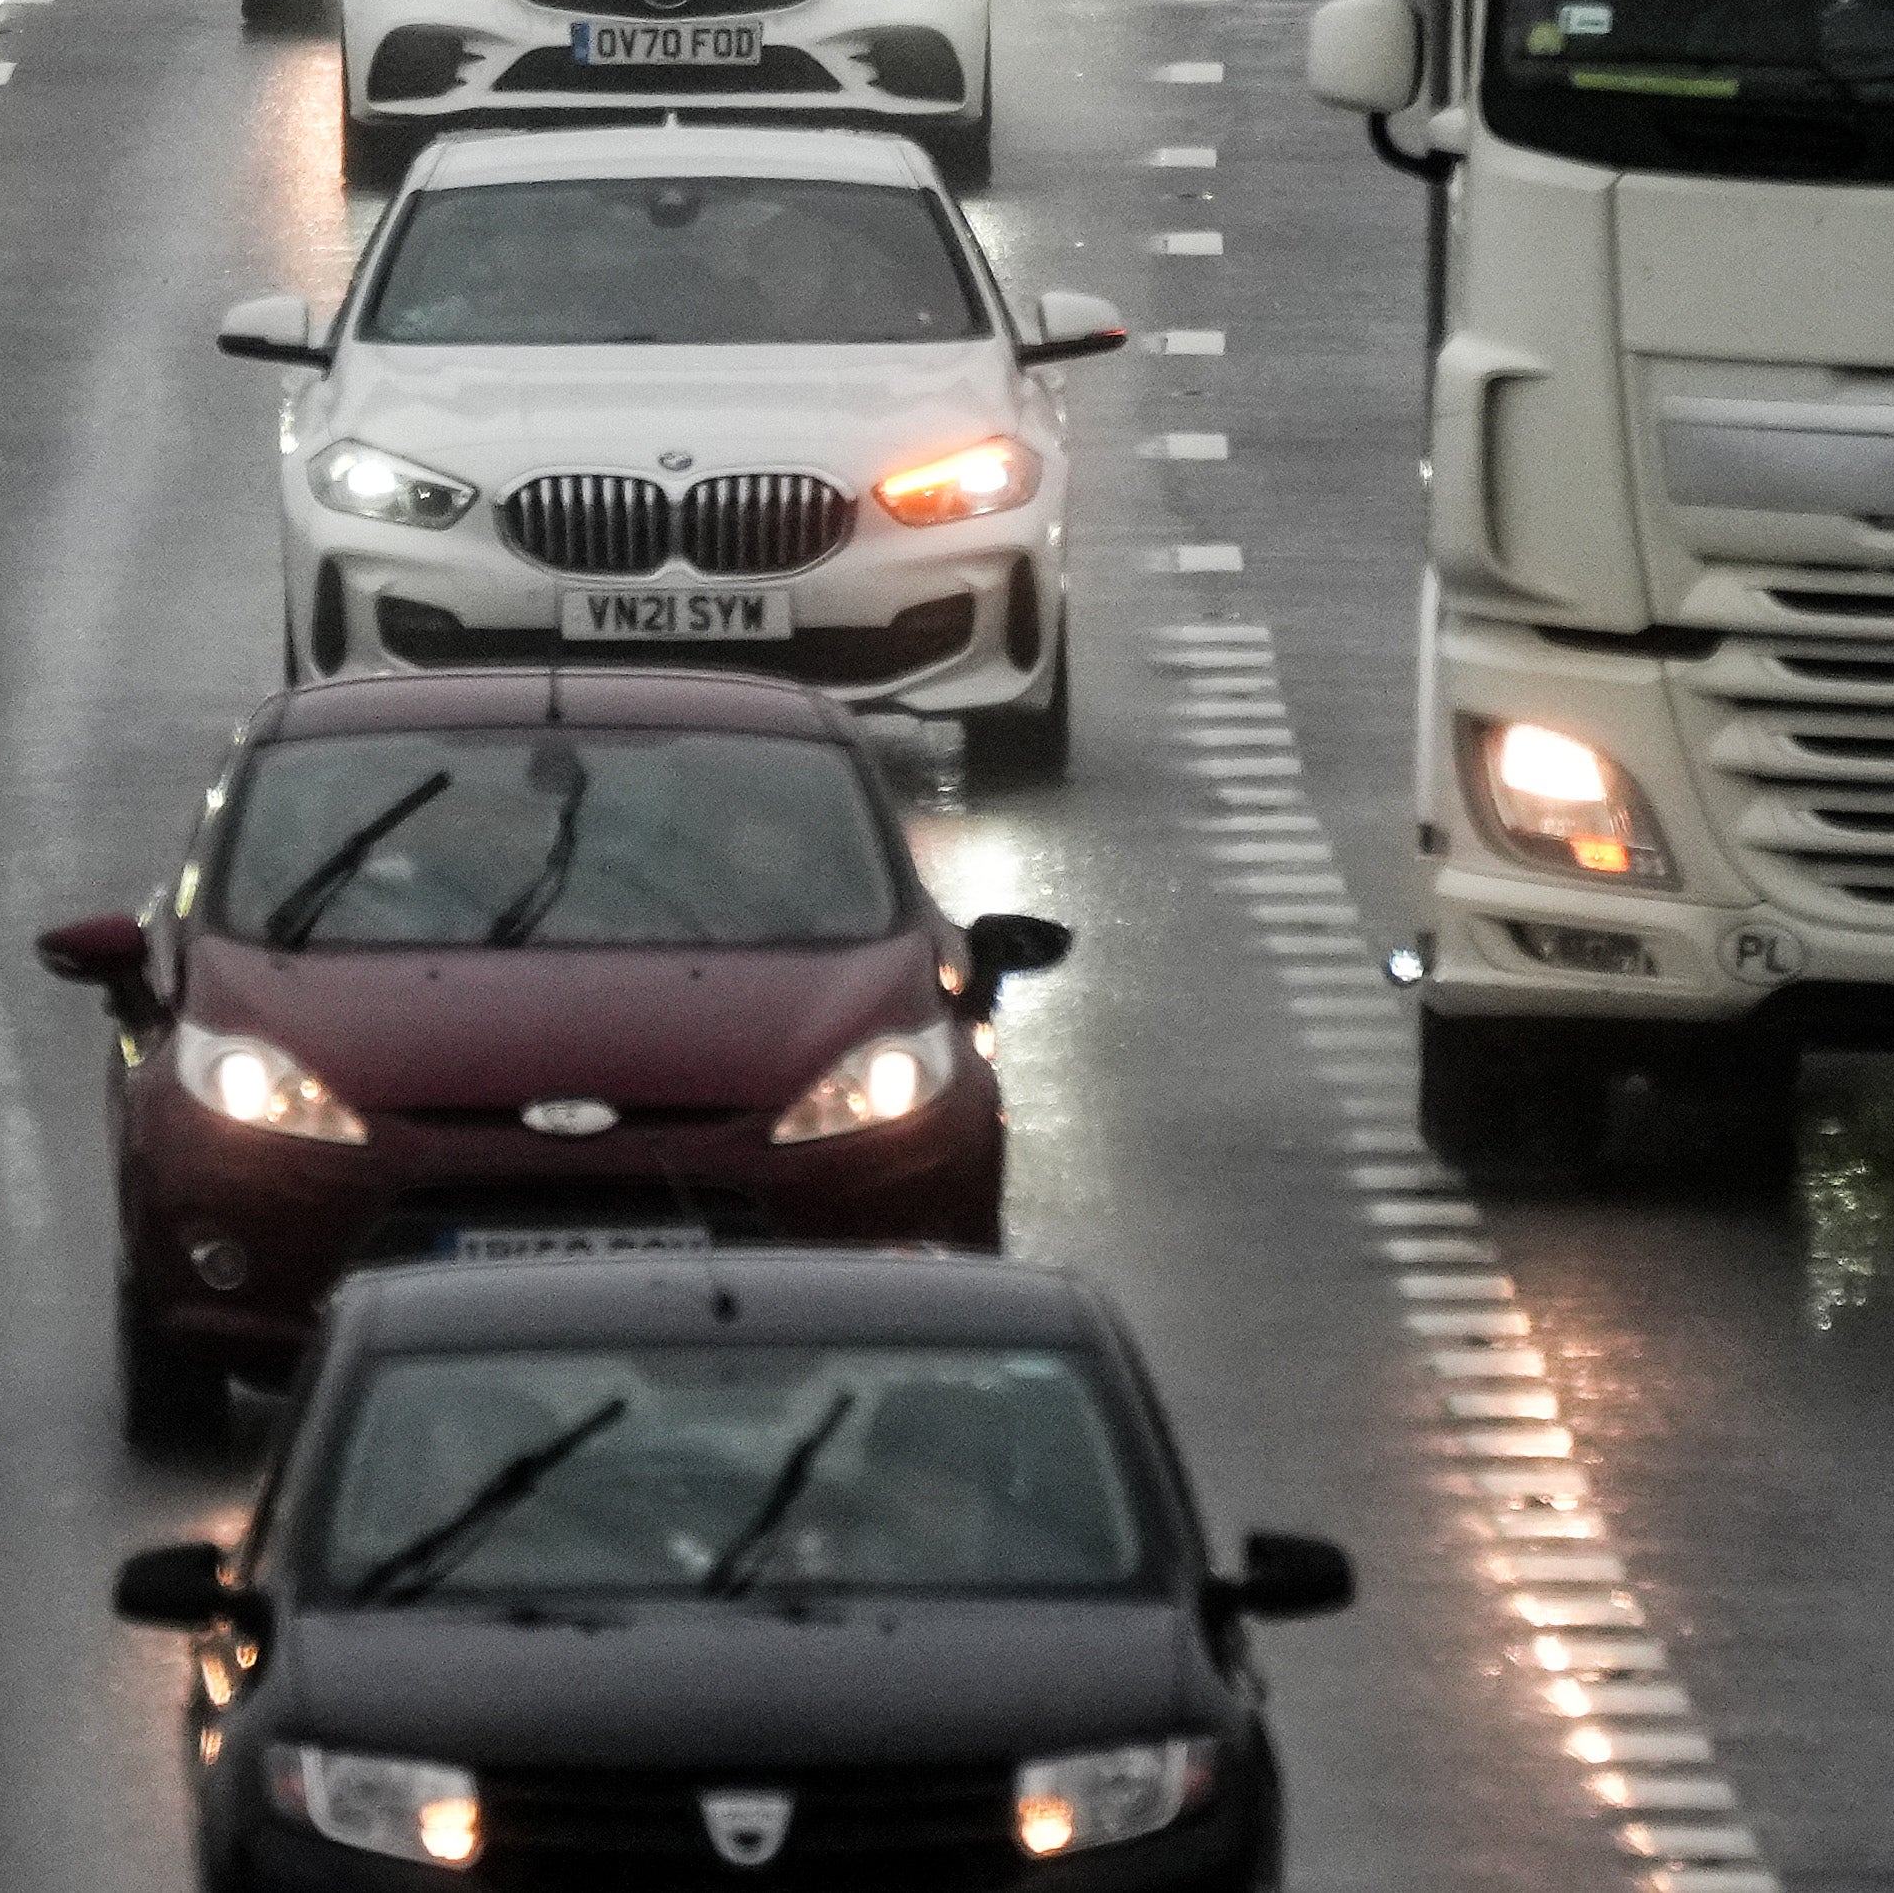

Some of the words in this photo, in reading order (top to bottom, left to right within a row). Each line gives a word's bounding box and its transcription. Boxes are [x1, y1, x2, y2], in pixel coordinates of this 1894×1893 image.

[596, 28, 682, 59] OV70
[587, 594, 677, 632] VN21
[687, 594, 765, 632] SYW
[1735, 933, 1790, 974] PL
